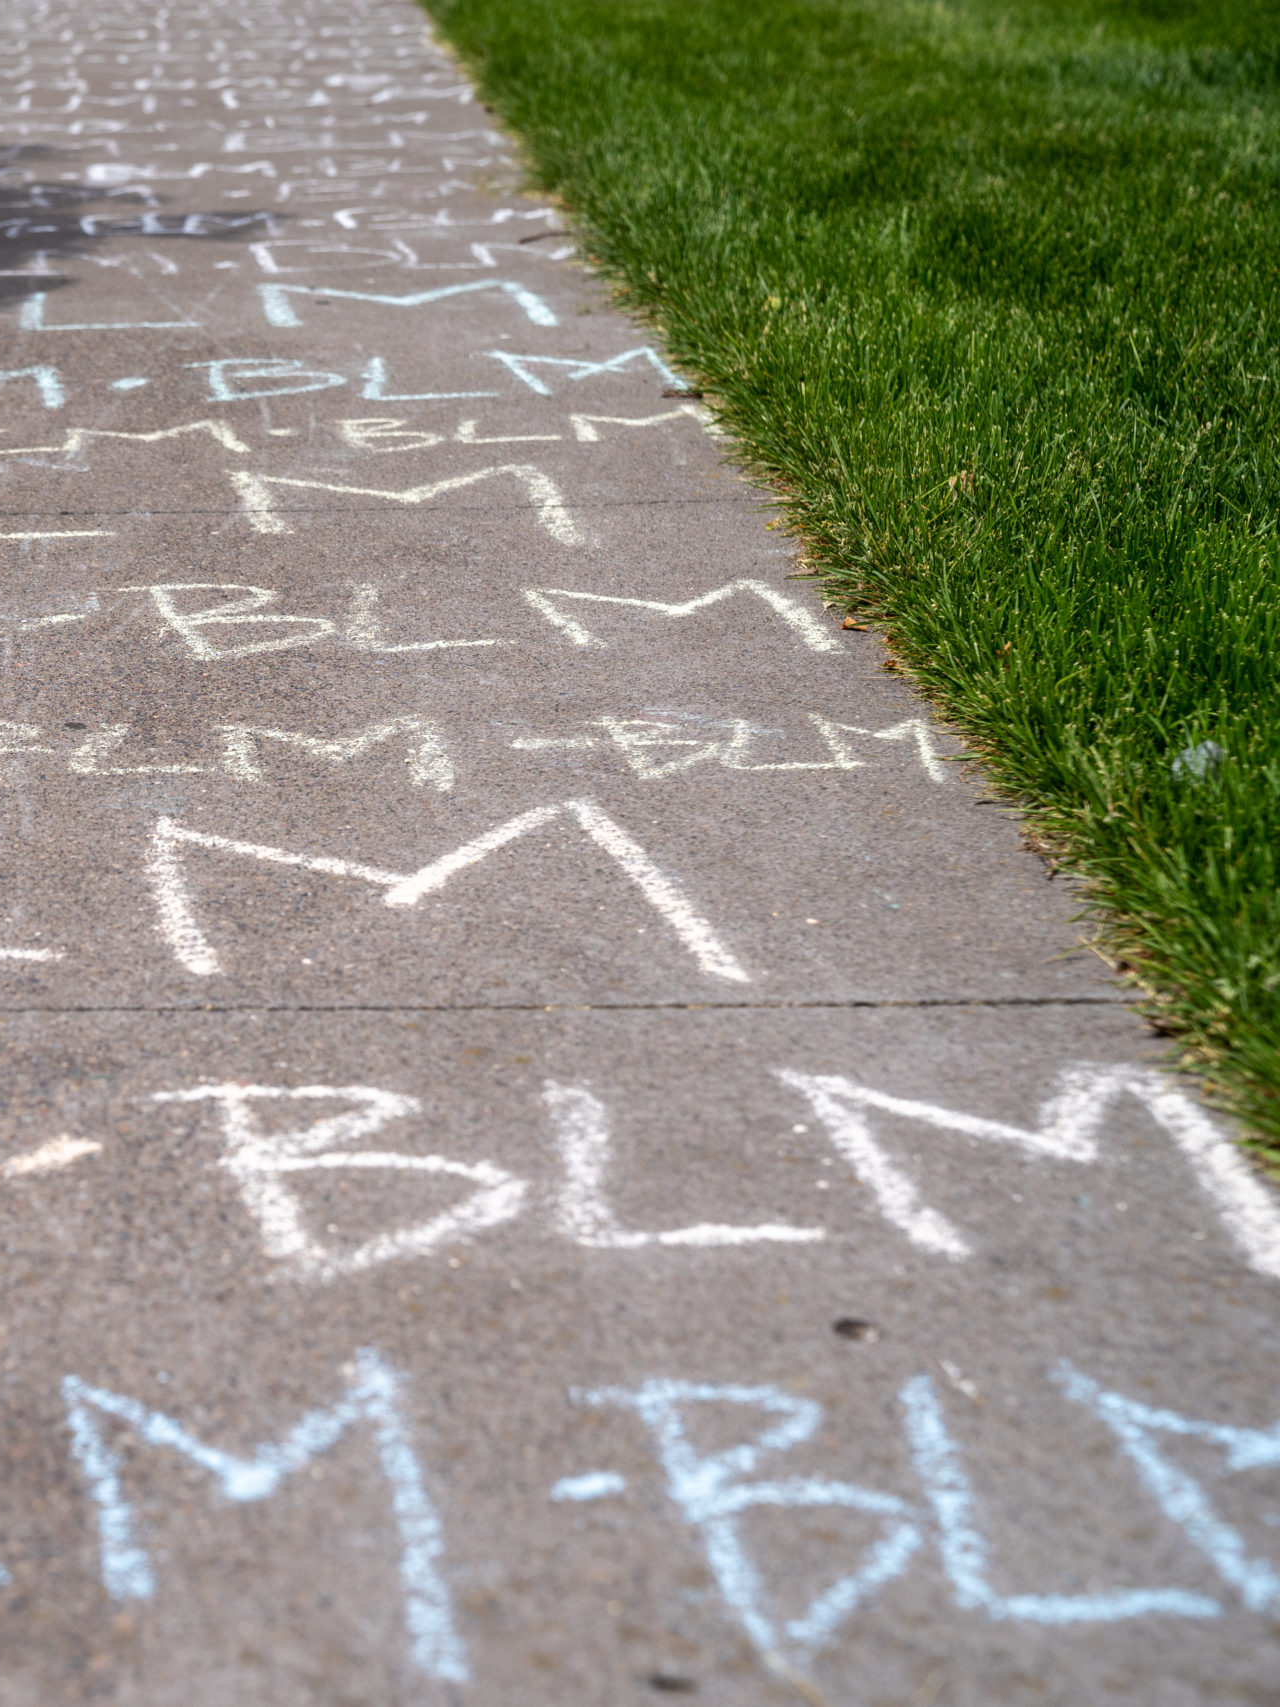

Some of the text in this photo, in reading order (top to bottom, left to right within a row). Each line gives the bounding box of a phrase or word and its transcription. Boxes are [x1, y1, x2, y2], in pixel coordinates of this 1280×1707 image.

[184, 346, 690, 402] BLM
[334, 402, 723, 453] BLM
[110, 578, 850, 661] BLM
[585, 711, 949, 784] BLM
[145, 1060, 1280, 1284] BLM
